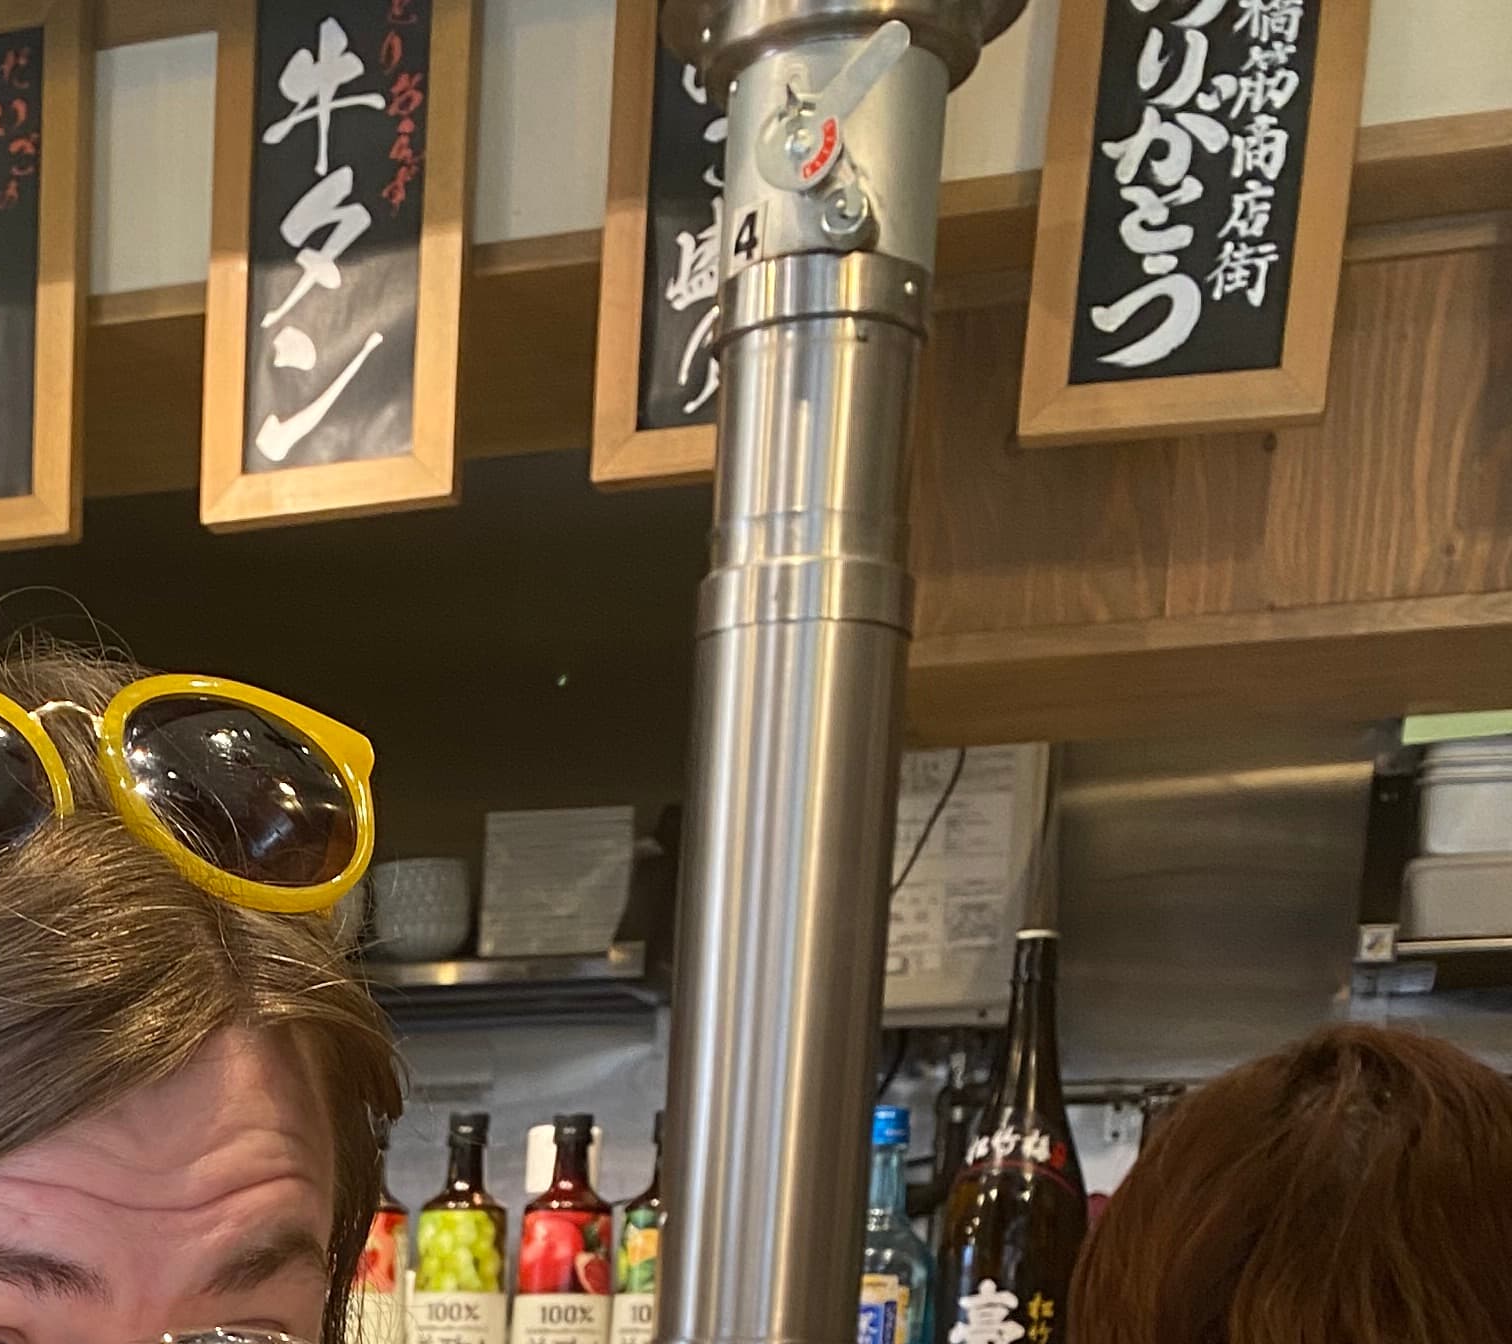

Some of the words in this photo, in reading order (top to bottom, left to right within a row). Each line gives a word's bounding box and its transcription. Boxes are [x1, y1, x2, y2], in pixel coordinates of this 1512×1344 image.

[1091, 0, 1238, 366] りがとう
[255, 16, 386, 463] 牛タン
[734, 210, 760, 260] 4
[428, 1303, 481, 1321] 100%
[541, 1304, 594, 1324] 100%
